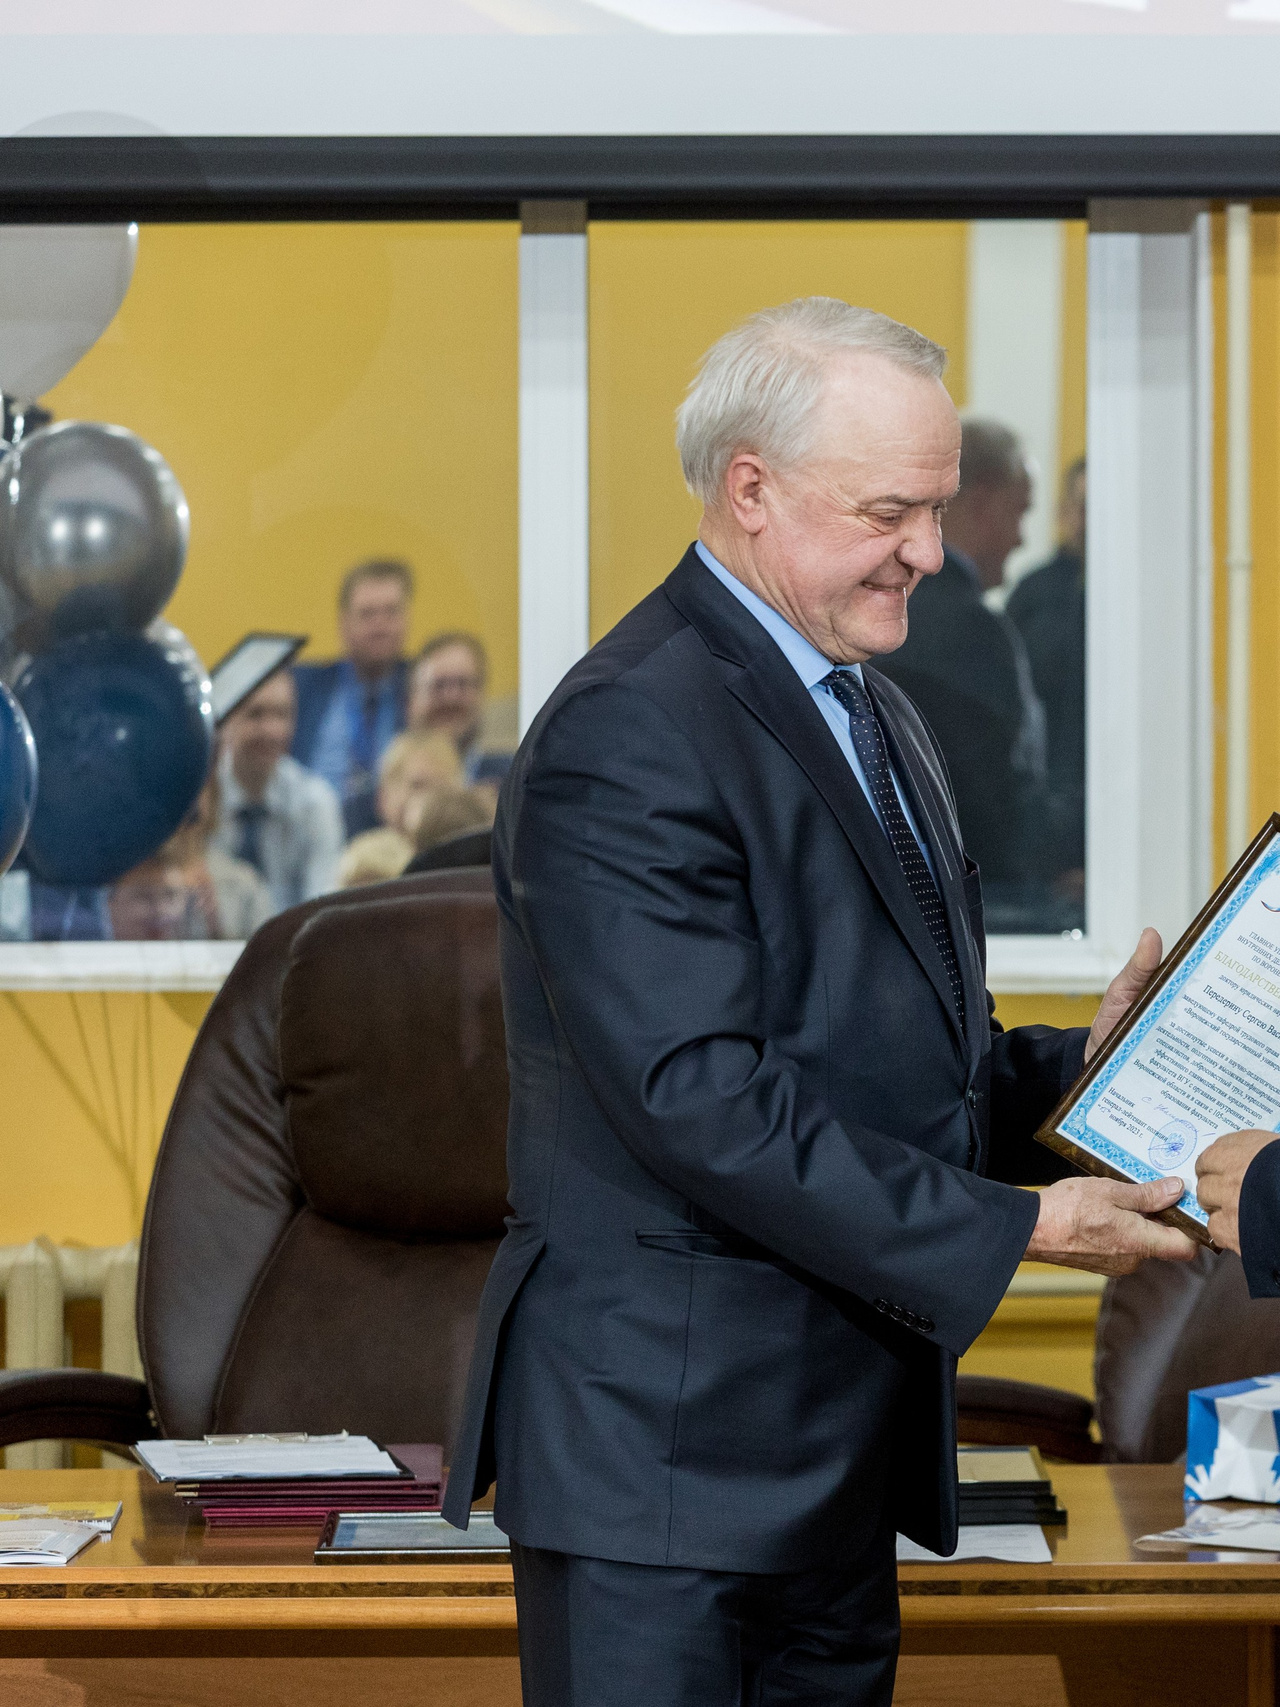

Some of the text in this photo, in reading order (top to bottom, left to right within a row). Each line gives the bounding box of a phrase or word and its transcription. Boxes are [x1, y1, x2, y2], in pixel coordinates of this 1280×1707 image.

[1235, 934, 1274, 960] ВНУТРЕННИХ
[1248, 931, 1275, 950] ГЛАВНОЕ
[1250, 954, 1262, 964] ПО
[1200, 983, 1245, 1016] Передерину
[1239, 1008, 1269, 1031] Сергею
[1217, 973, 1240, 991] доктору
[1237, 986, 1274, 1012] юридических
[1154, 1024, 1192, 1051] деятельности,
[1188, 1046, 1219, 1068] подготовку
[1173, 1024, 1208, 1049] достигнутые
[1205, 1044, 1226, 1060] успехи
[1180, 993, 1217, 1019] заведующему
[1214, 1013, 1242, 1034] кафедрой
[1238, 1029, 1266, 1050] трудового
[1263, 1045, 1280, 1059] права
[1181, 1005, 1222, 1033] «Воронежский
[1217, 1028, 1263, 1060] государственный
[1106, 1086, 1137, 1108] Начальник
[1131, 1058, 1168, 1084] Воронежской
[1165, 1078, 1188, 1096] области
[1193, 1098, 1209, 1111] связи
[1211, 1109, 1242, 1131] 105-летием
[1147, 1055, 1179, 1079] факультета
[1175, 1073, 1190, 1085] ВГУ
[1190, 1085, 1216, 1104] органами
[1214, 1100, 1245, 1122] внутренних
[1243, 1118, 1255, 1128] дел
[1152, 1047, 1263, 1121] эффективного взаимодействия юридического
[1154, 1036, 1274, 1116] специалистов, добросовестный труд, укрепление
[1099, 1095, 1148, 1129] генерал-лейтенант
[1144, 1124, 1169, 1143] полиции
[1107, 1112, 1128, 1129] ноября
[1125, 1123, 1140, 1136] 2023
[1158, 1088, 1220, 1130] образования факультета
